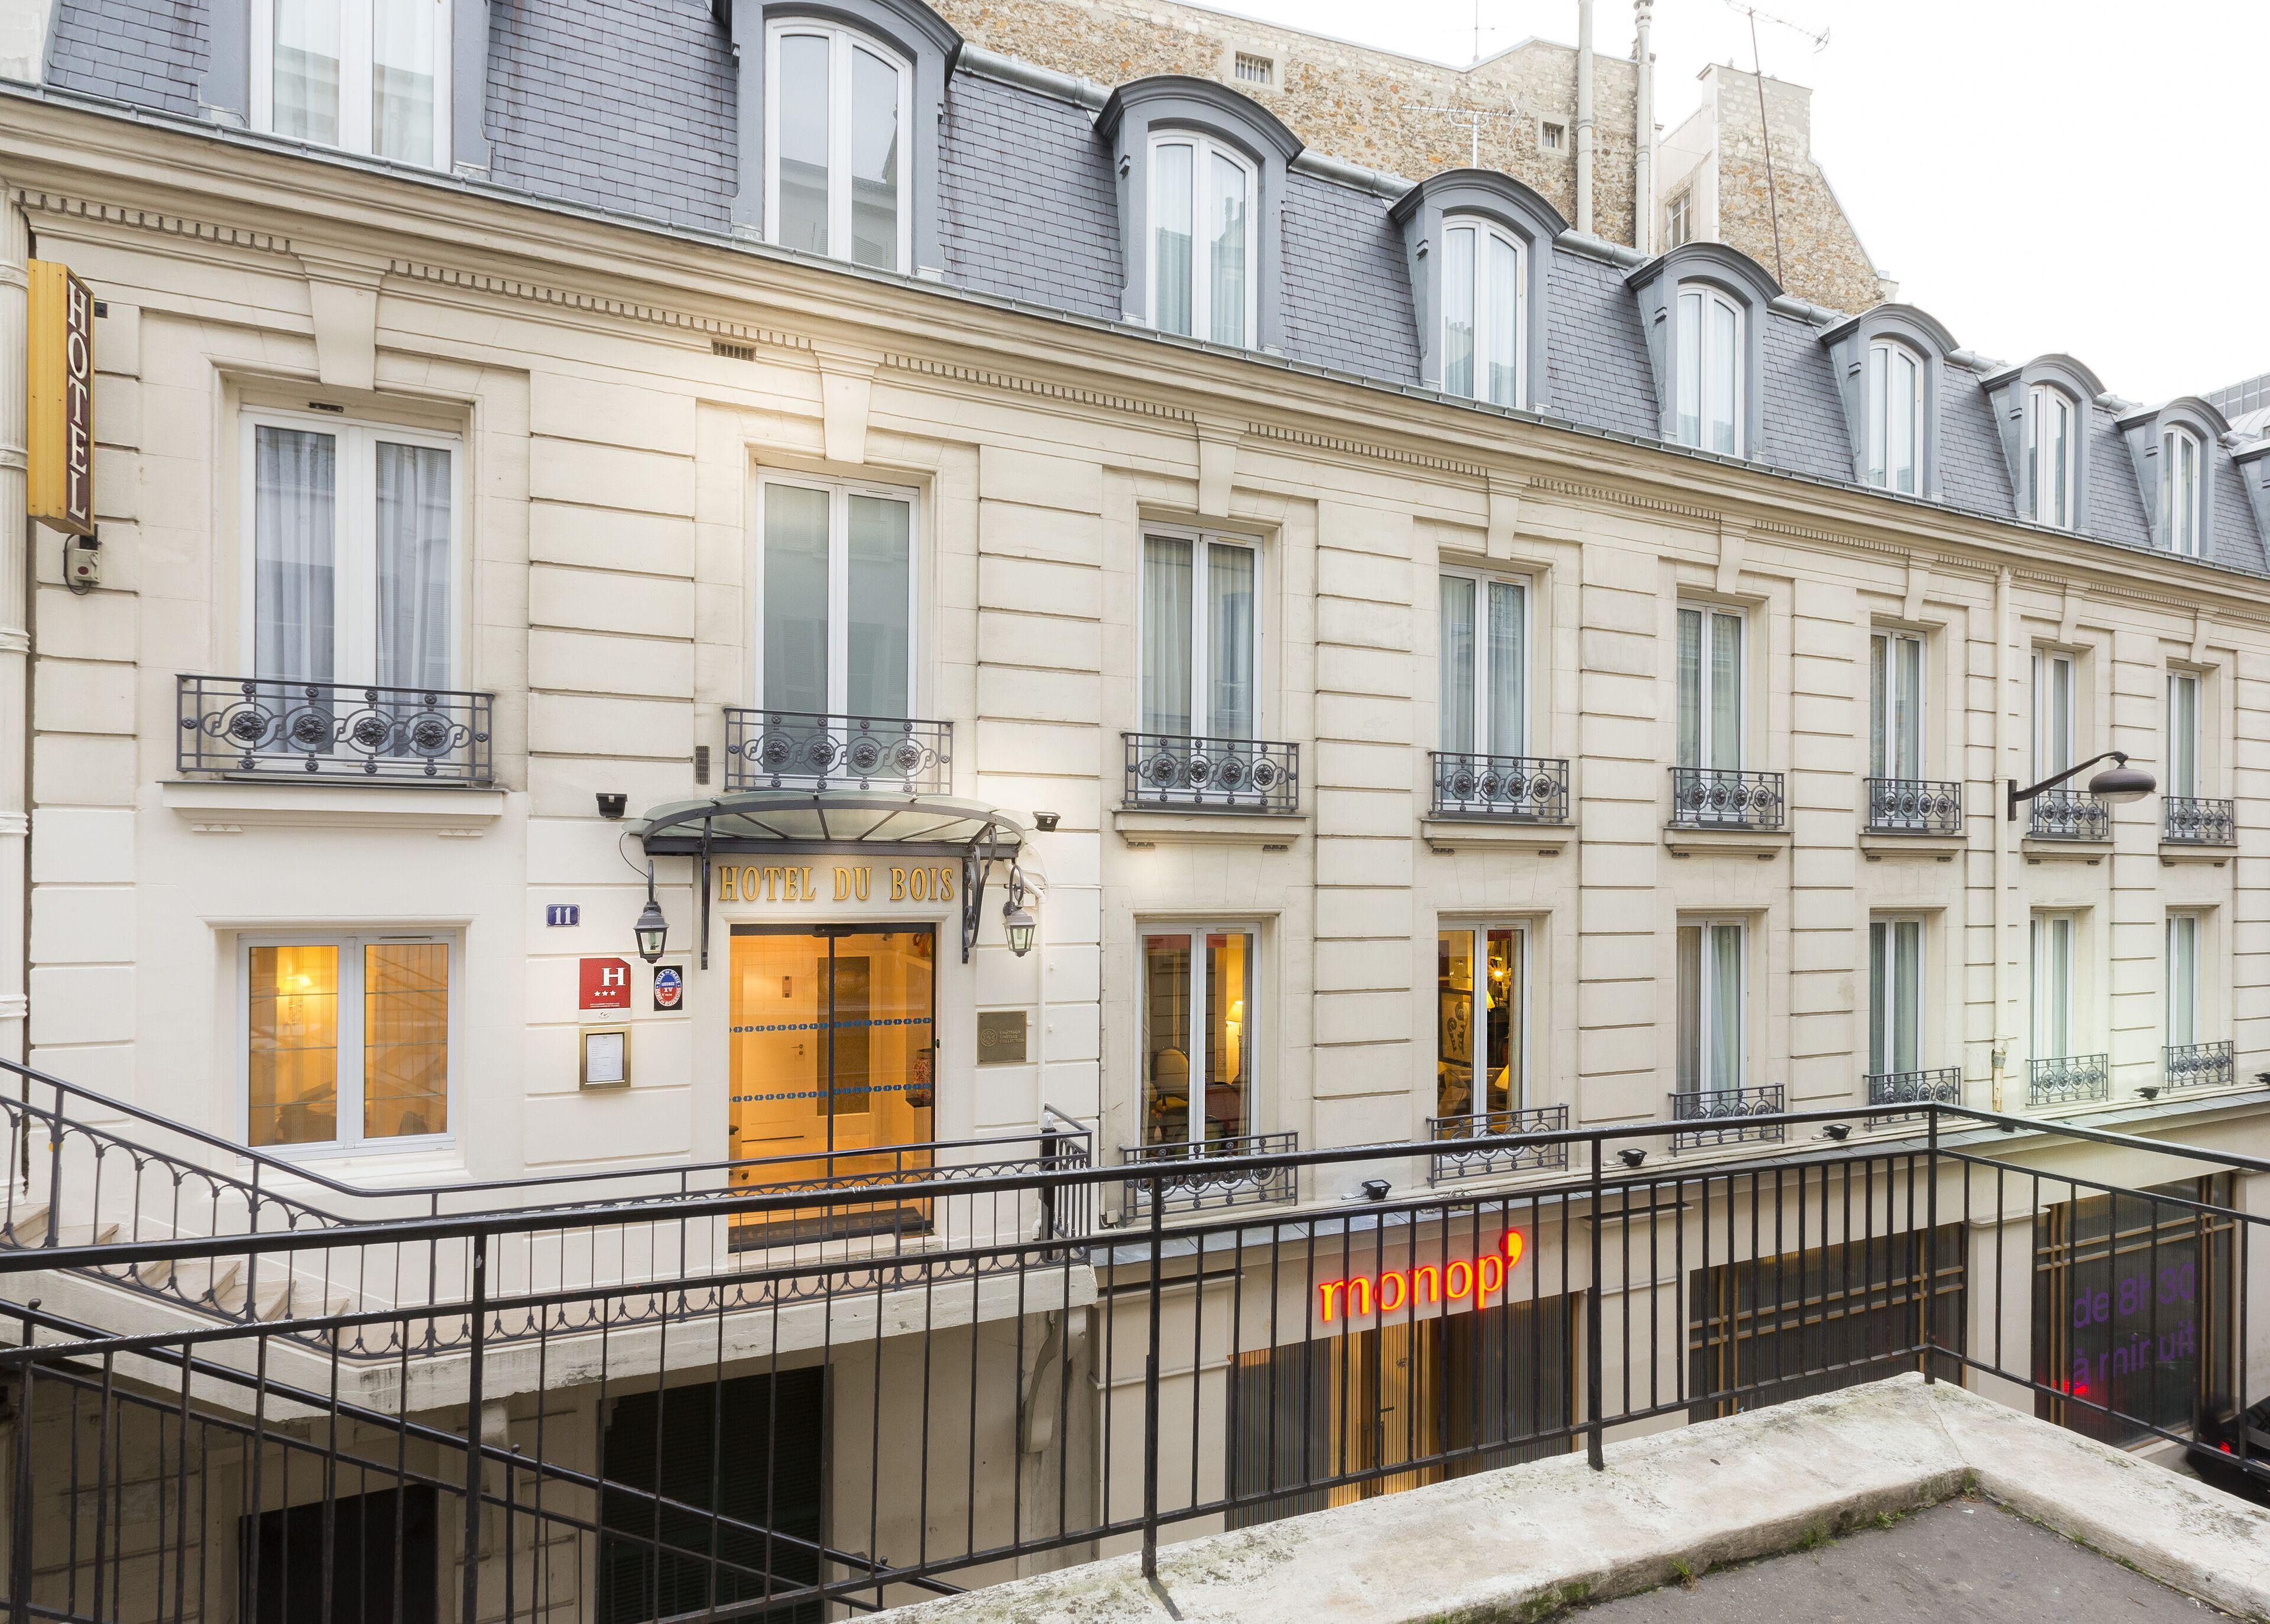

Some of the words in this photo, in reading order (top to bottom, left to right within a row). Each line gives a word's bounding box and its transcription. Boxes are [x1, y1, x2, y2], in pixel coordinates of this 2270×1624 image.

[67, 279, 88, 521] HOTEL
[718, 866, 816, 900] HOTEL
[832, 867, 871, 900] DU
[889, 867, 955, 900] BOIS
[554, 907, 572, 925] 11
[601, 967, 626, 986] H
[2074, 1286, 2109, 1328] de
